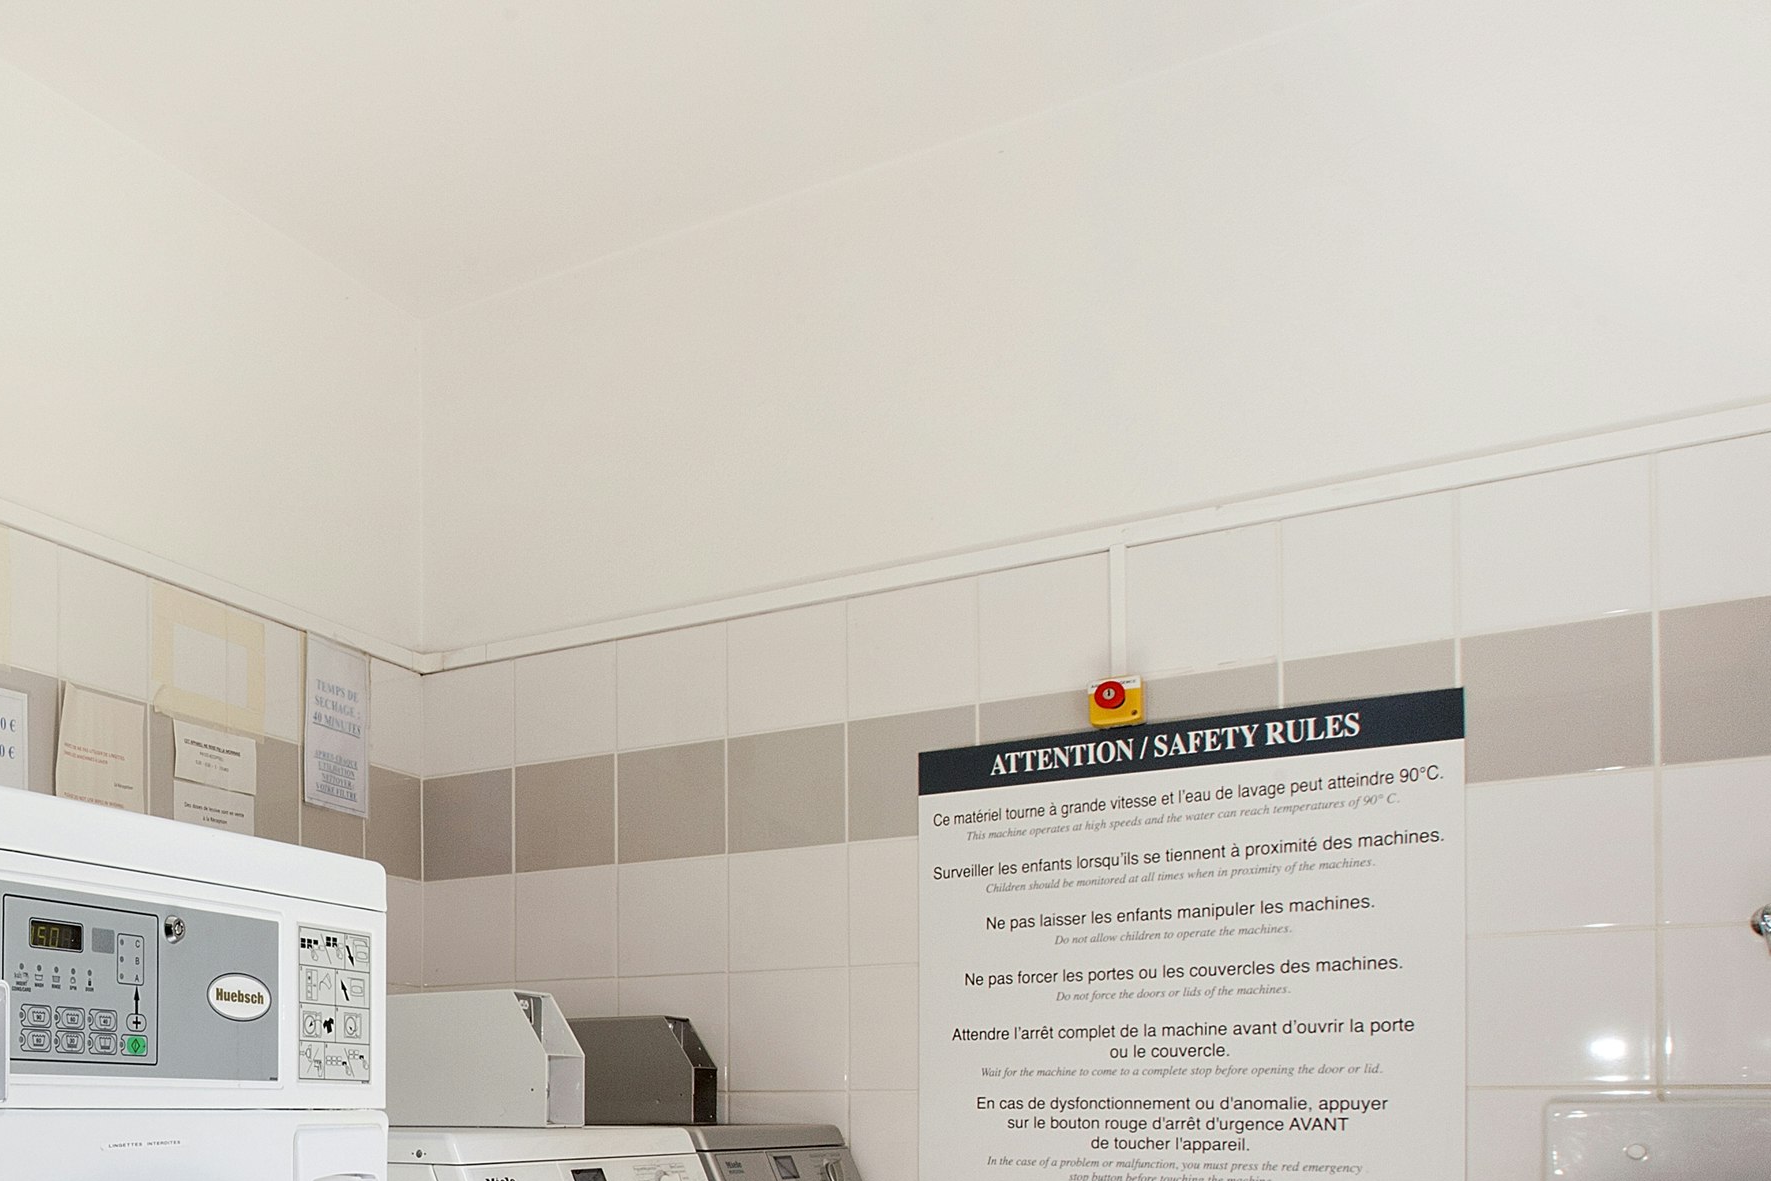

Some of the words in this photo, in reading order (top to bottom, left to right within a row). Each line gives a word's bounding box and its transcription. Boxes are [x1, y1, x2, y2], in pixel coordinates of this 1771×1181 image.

[316, 679, 346, 700] TEMPS
[347, 689, 358, 702] DE
[314, 695, 356, 718] SECHAGE
[9, 719, 17, 732] €
[312, 710, 323, 723] 40
[324, 714, 361, 736] MINUTES
[8, 746, 15, 759] €
[989, 737, 1134, 776] ATTENTION
[1153, 723, 1259, 758] SAFETY
[1264, 711, 1360, 745] RULES
[932, 812, 950, 827] Ce
[953, 807, 1001, 825] matériel
[1005, 805, 1045, 820] tourne
[1048, 801, 1057, 816] à
[1060, 797, 1106, 818] grande
[1109, 795, 1157, 810] vitesse
[1160, 791, 1174, 805] et
[1177, 788, 1211, 803] l'eau
[1214, 785, 1233, 800] de
[1237, 782, 1285, 799] lavage
[1289, 777, 1323, 797] peut
[1327, 770, 1394, 790] atteindre
[134, 939, 141, 949] C
[135, 957, 140, 966] B
[134, 974, 140, 983] A
[216, 987, 264, 1005] Huebsch
[976, 1095, 995, 1109] En
[998, 1098, 1024, 1110] cas
[1027, 1096, 1045, 1110] de
[1049, 1095, 1190, 1113] dysfonctionnement
[1194, 1098, 1214, 1110] ou
[1317, 1098, 1388, 1114] appuyer
[1007, 1117, 1029, 1129] sur
[1033, 1115, 1046, 1129] le
[1050, 1115, 1100, 1129] bouton
[1104, 1118, 1147, 1133] rouge
[1151, 1115, 1201, 1130] d'arrêt
[1205, 1116, 1284, 1134] d'urgence
[1288, 1116, 1349, 1131] AVANT
[1090, 1135, 1109, 1149] de
[1113, 1136, 1171, 1150] toucher
[1175, 1136, 1249, 1154] l'appareil.
